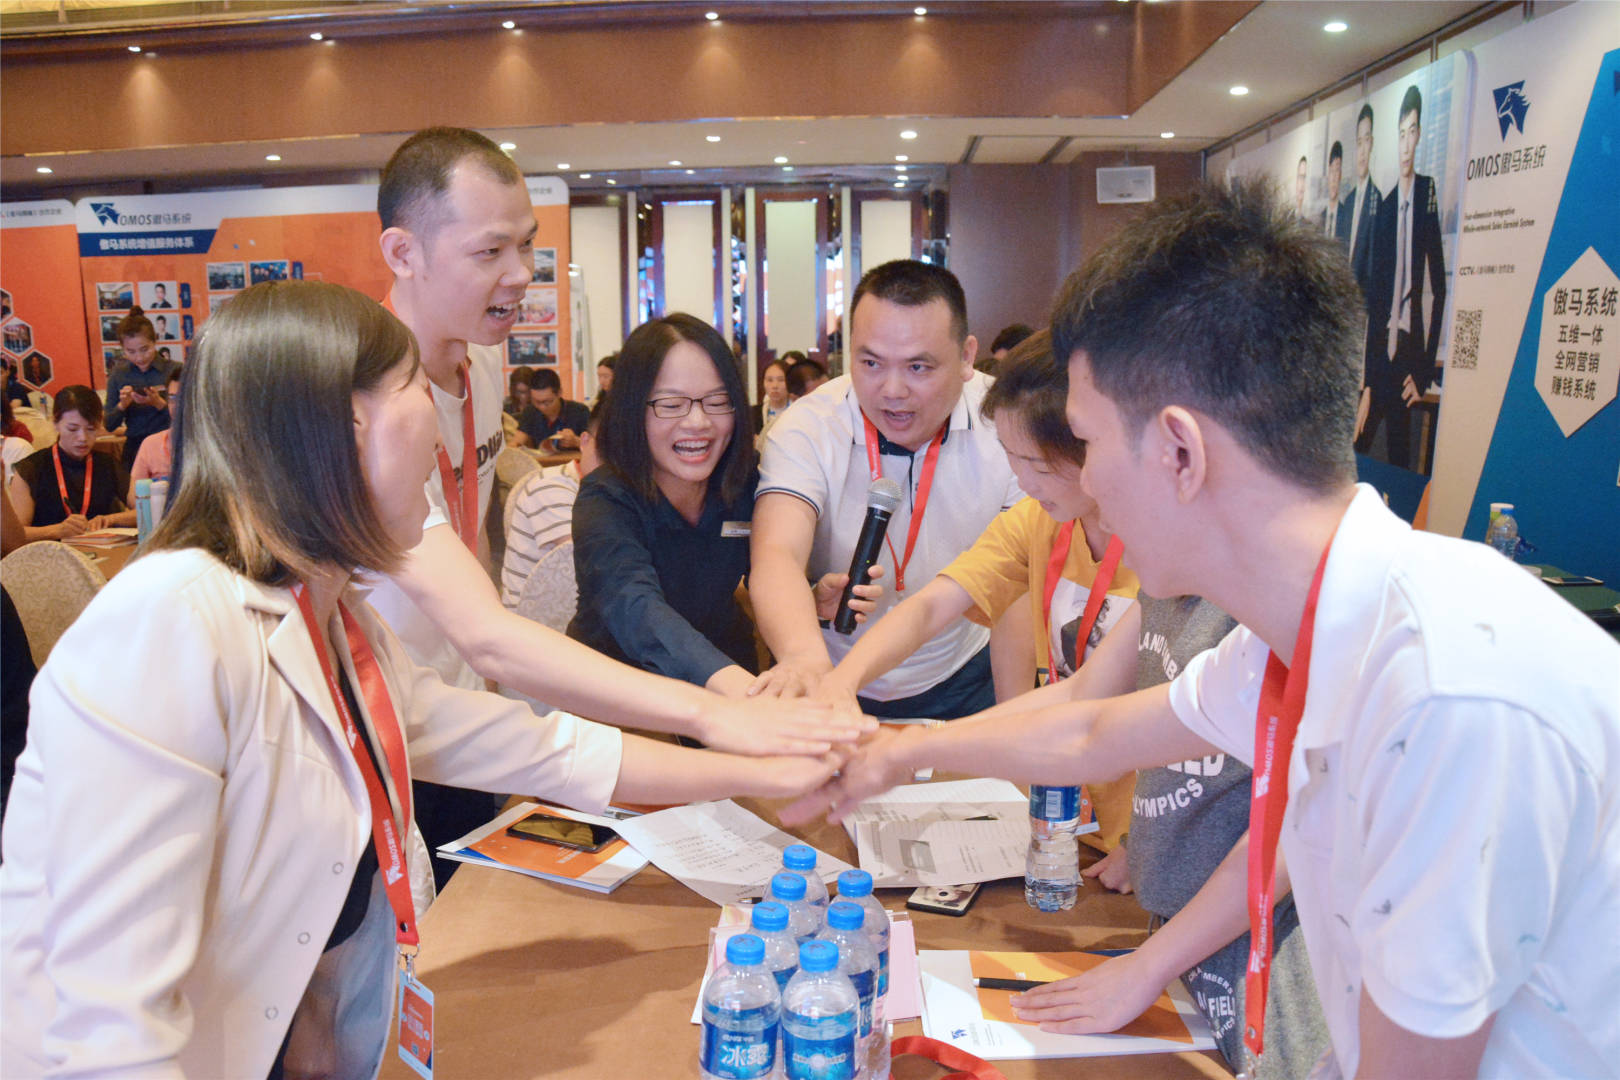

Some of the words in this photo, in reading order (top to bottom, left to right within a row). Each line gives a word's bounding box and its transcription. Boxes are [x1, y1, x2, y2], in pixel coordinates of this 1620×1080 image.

[1553, 286, 1618, 316] 傲马系统
[1557, 324, 1604, 346] 五维一体
[1554, 350, 1600, 373] 全网营销
[1551, 375, 1597, 400] 赚钱系统
[720, 1042, 770, 1067] 冰露
